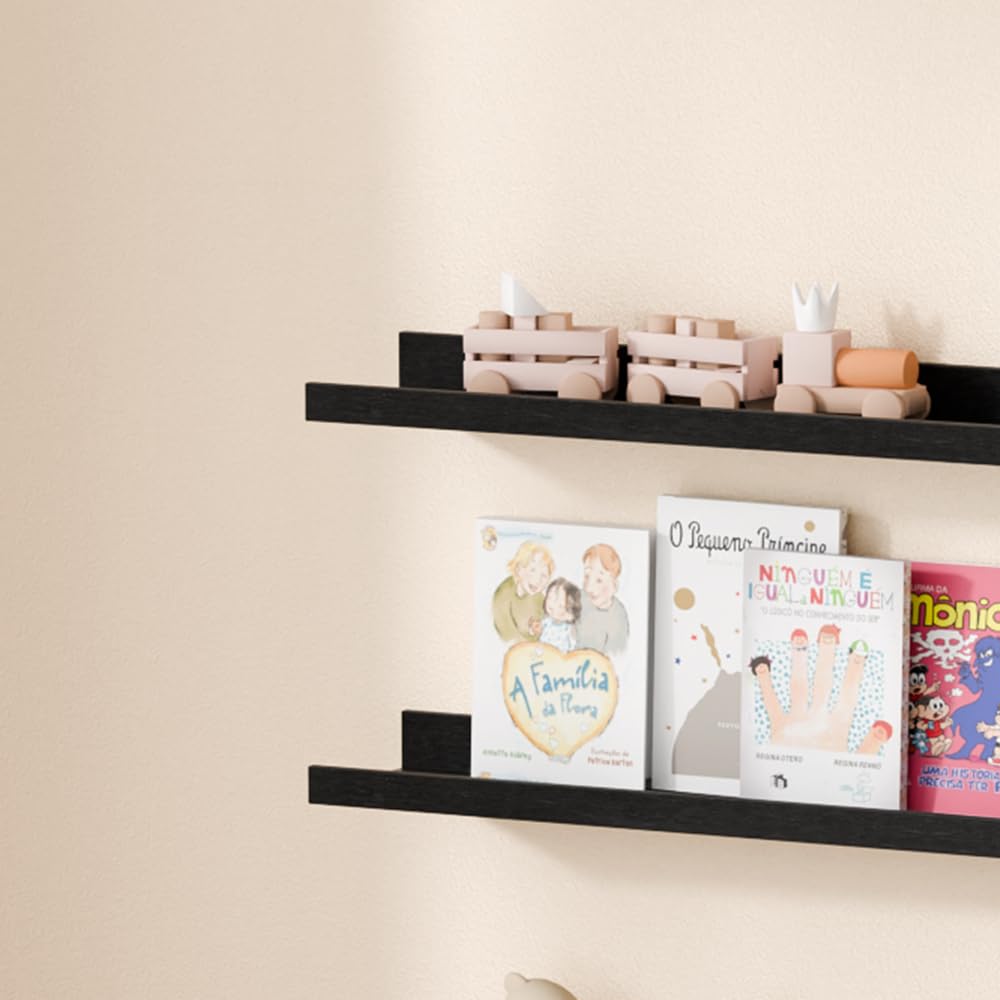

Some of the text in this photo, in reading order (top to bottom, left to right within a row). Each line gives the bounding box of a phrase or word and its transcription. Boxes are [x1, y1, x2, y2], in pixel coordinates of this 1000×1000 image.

[670, 520, 683, 548] O
[530, 660, 609, 696] Família
[509, 676, 532, 718] A
